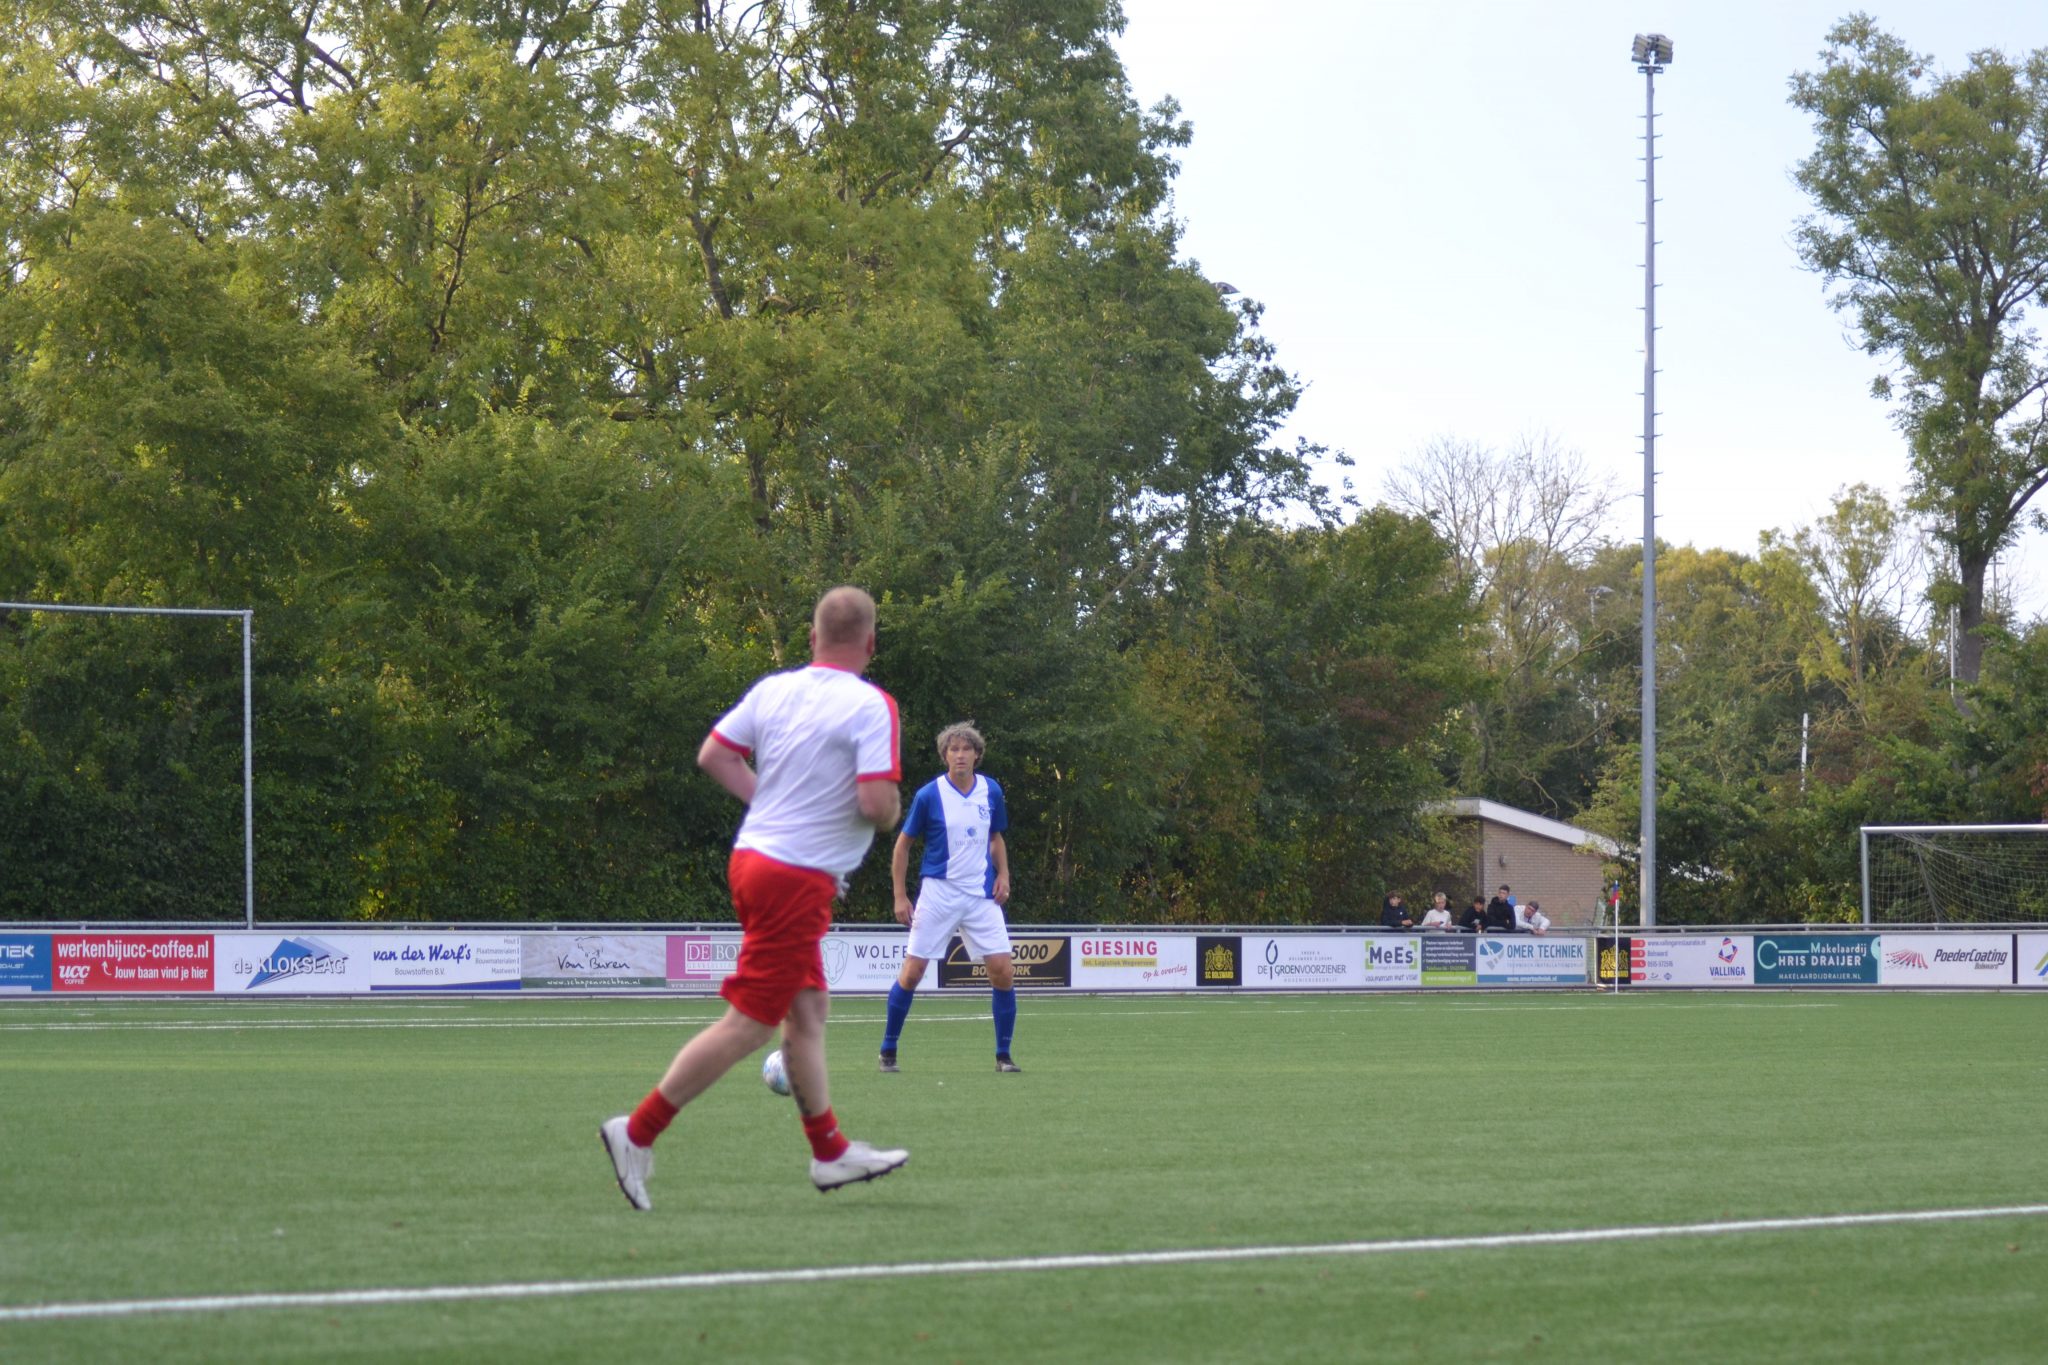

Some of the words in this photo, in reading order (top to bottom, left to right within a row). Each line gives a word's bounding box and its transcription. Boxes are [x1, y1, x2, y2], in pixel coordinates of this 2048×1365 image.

[57, 940, 209, 961] werkenbijucc-coffee.nl
[373, 949, 397, 961] van
[401, 945, 425, 961] der
[428, 944, 471, 963] Werf's
[688, 944, 710, 960] DE
[1081, 941, 1158, 956] GIESING
[1369, 946, 1414, 964] MeEs
[1507, 945, 1534, 958] OMER
[1537, 945, 1584, 958] TECHNIEK
[1810, 943, 1867, 957] Makelaardij
[557, 954, 584, 971] Van
[589, 957, 631, 970] Buren
[1811, 955, 1862, 966] DRAIJER
[1934, 948, 2008, 965] PoederCoating
[233, 958, 252, 974] de
[258, 955, 346, 974] KLOKSLAG
[394, 967, 433, 975] Bouwstoffen
[434, 967, 445, 975] B.V.
[1161, 964, 1188, 976] overslag
[1257, 965, 1268, 974] DE
[1274, 965, 1346, 976] GROENVOORZIENER
[1709, 966, 1746, 976] VALLINGA
[114, 966, 135, 979] Jouw
[138, 966, 157, 979] baan
[160, 966, 179, 979] vind
[181, 967, 189, 981] je
[191, 966, 208, 979] hier
[1778, 972, 1862, 980] MAKELAARDIJDRAIJER.NL
